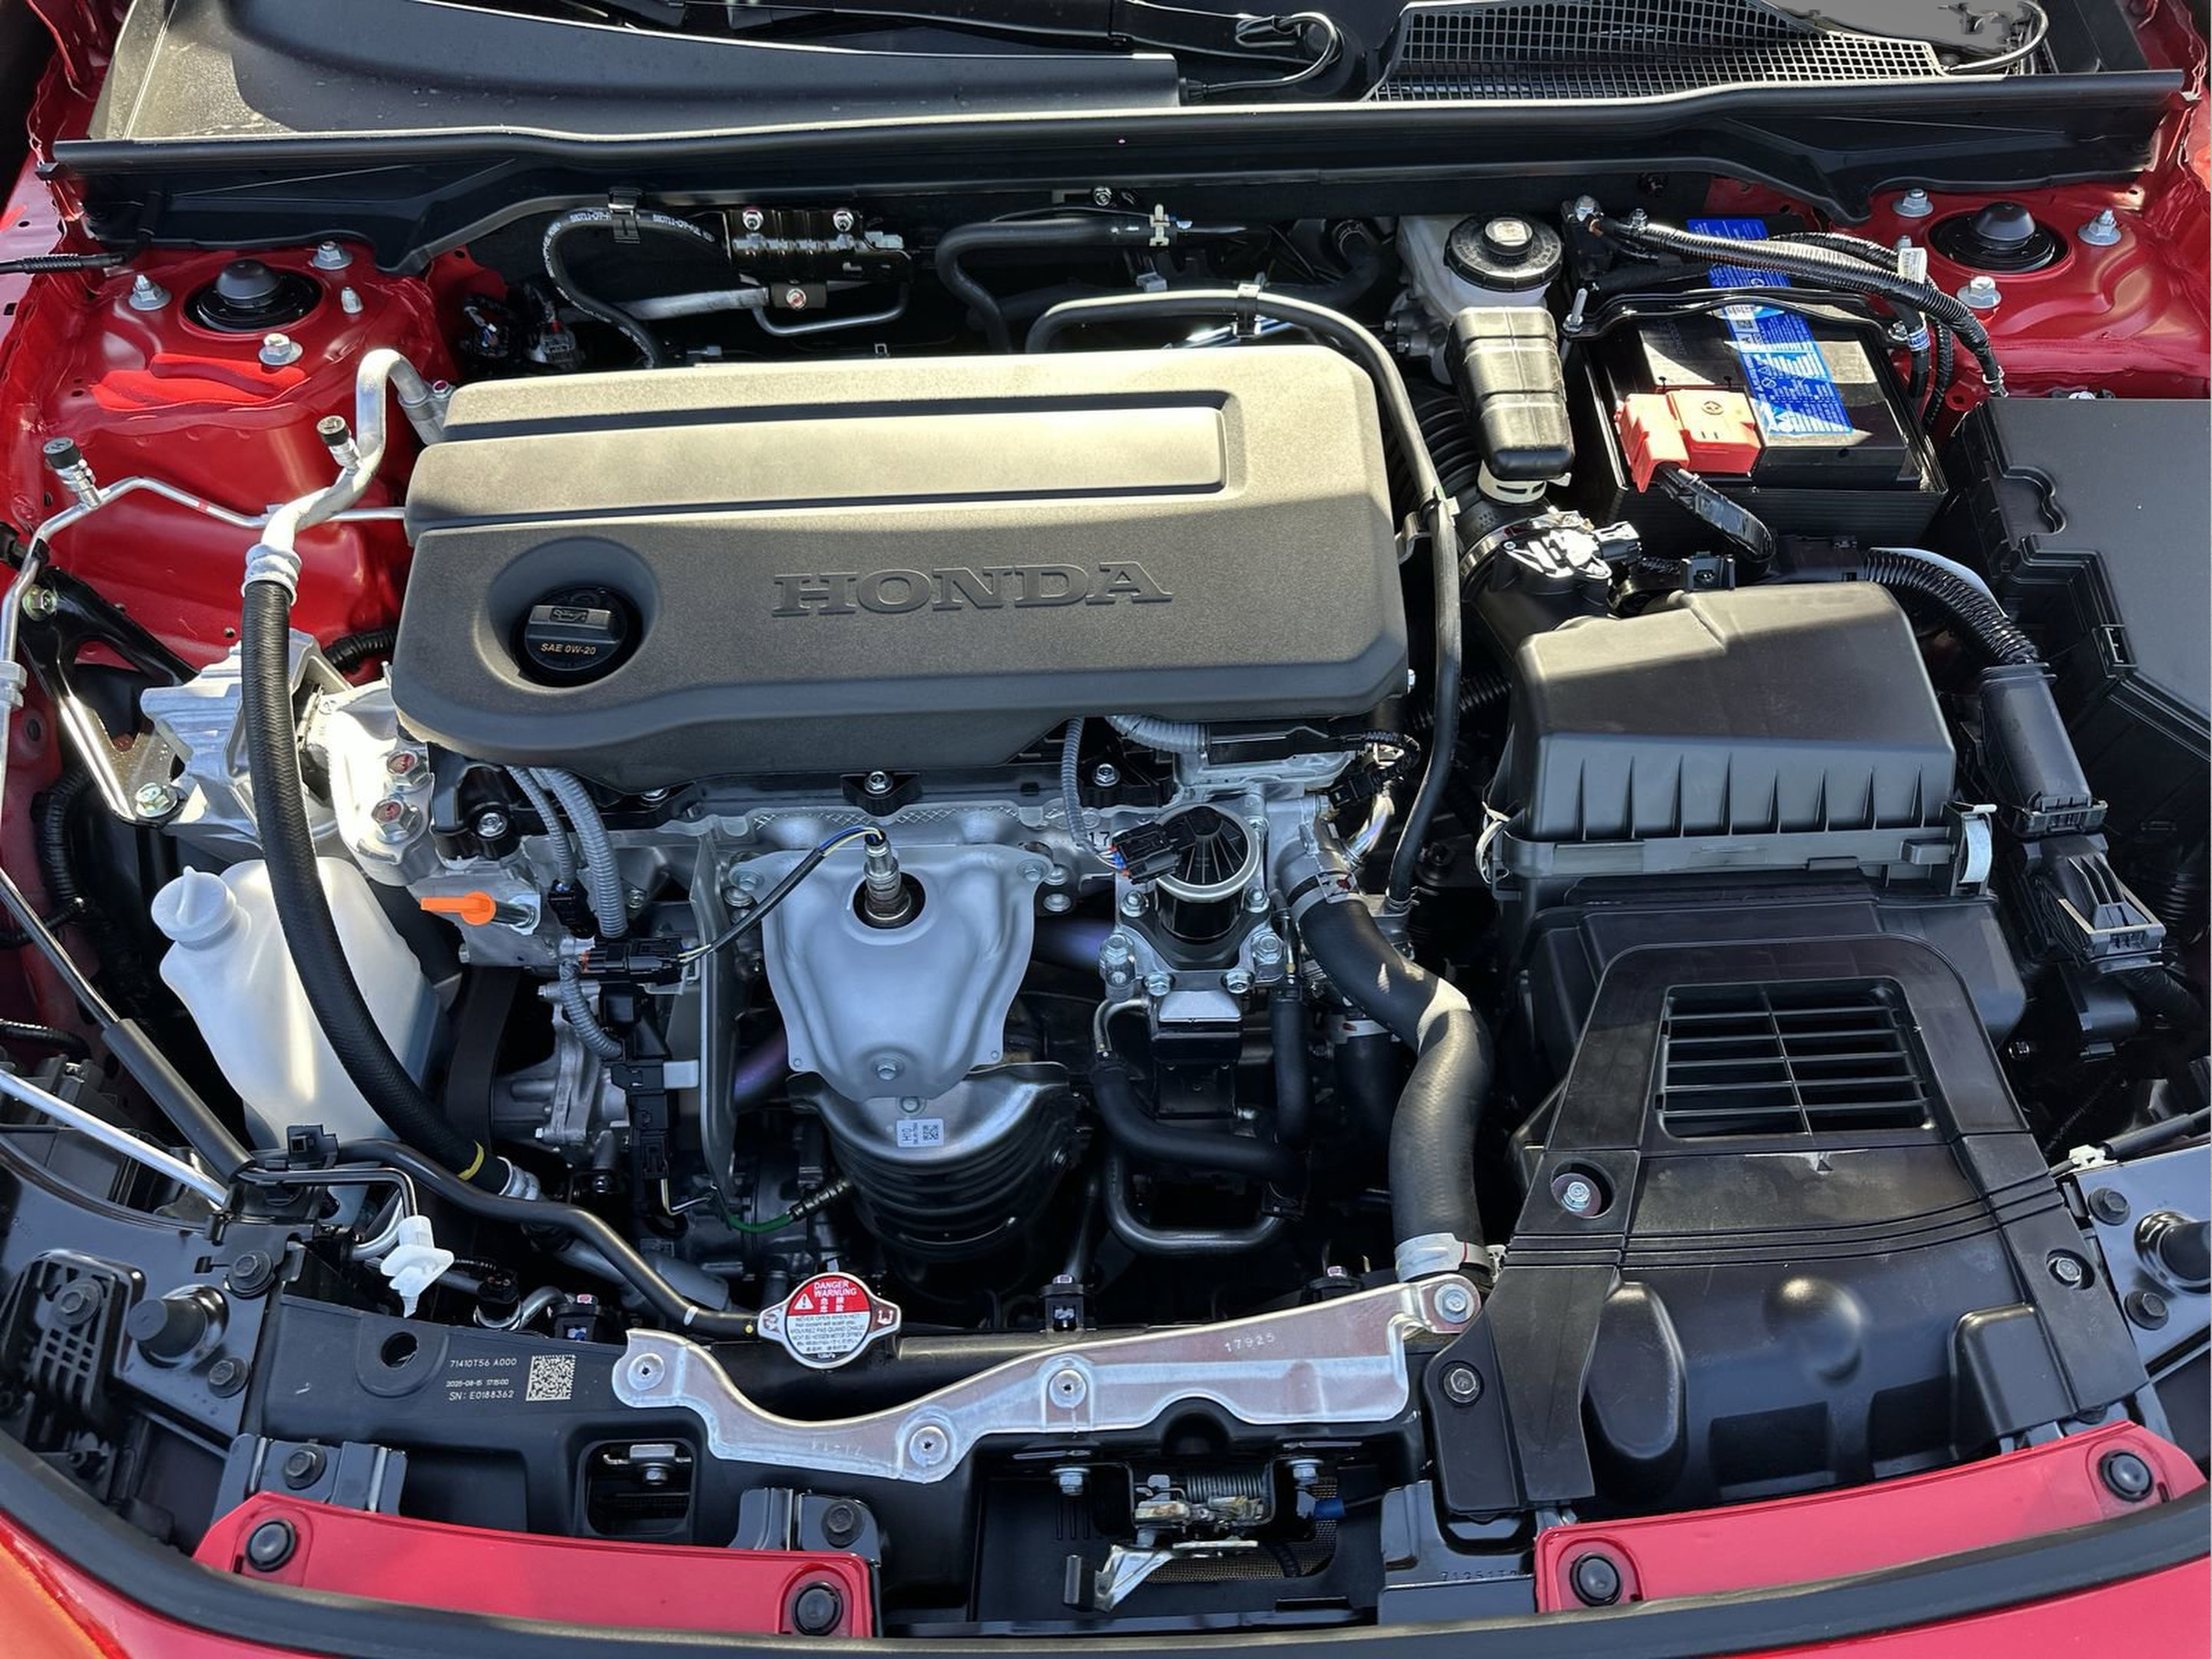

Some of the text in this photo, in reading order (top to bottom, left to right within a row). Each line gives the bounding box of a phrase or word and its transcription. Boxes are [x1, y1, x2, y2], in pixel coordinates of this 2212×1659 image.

[772, 561, 1173, 617] HONDA
[541, 643, 596, 655] SAE 0W-20
[814, 1280, 849, 1290] DANGER
[449, 1358, 518, 1368] 71410T56 A000
[449, 1390, 515, 1401] SN: E0188362
